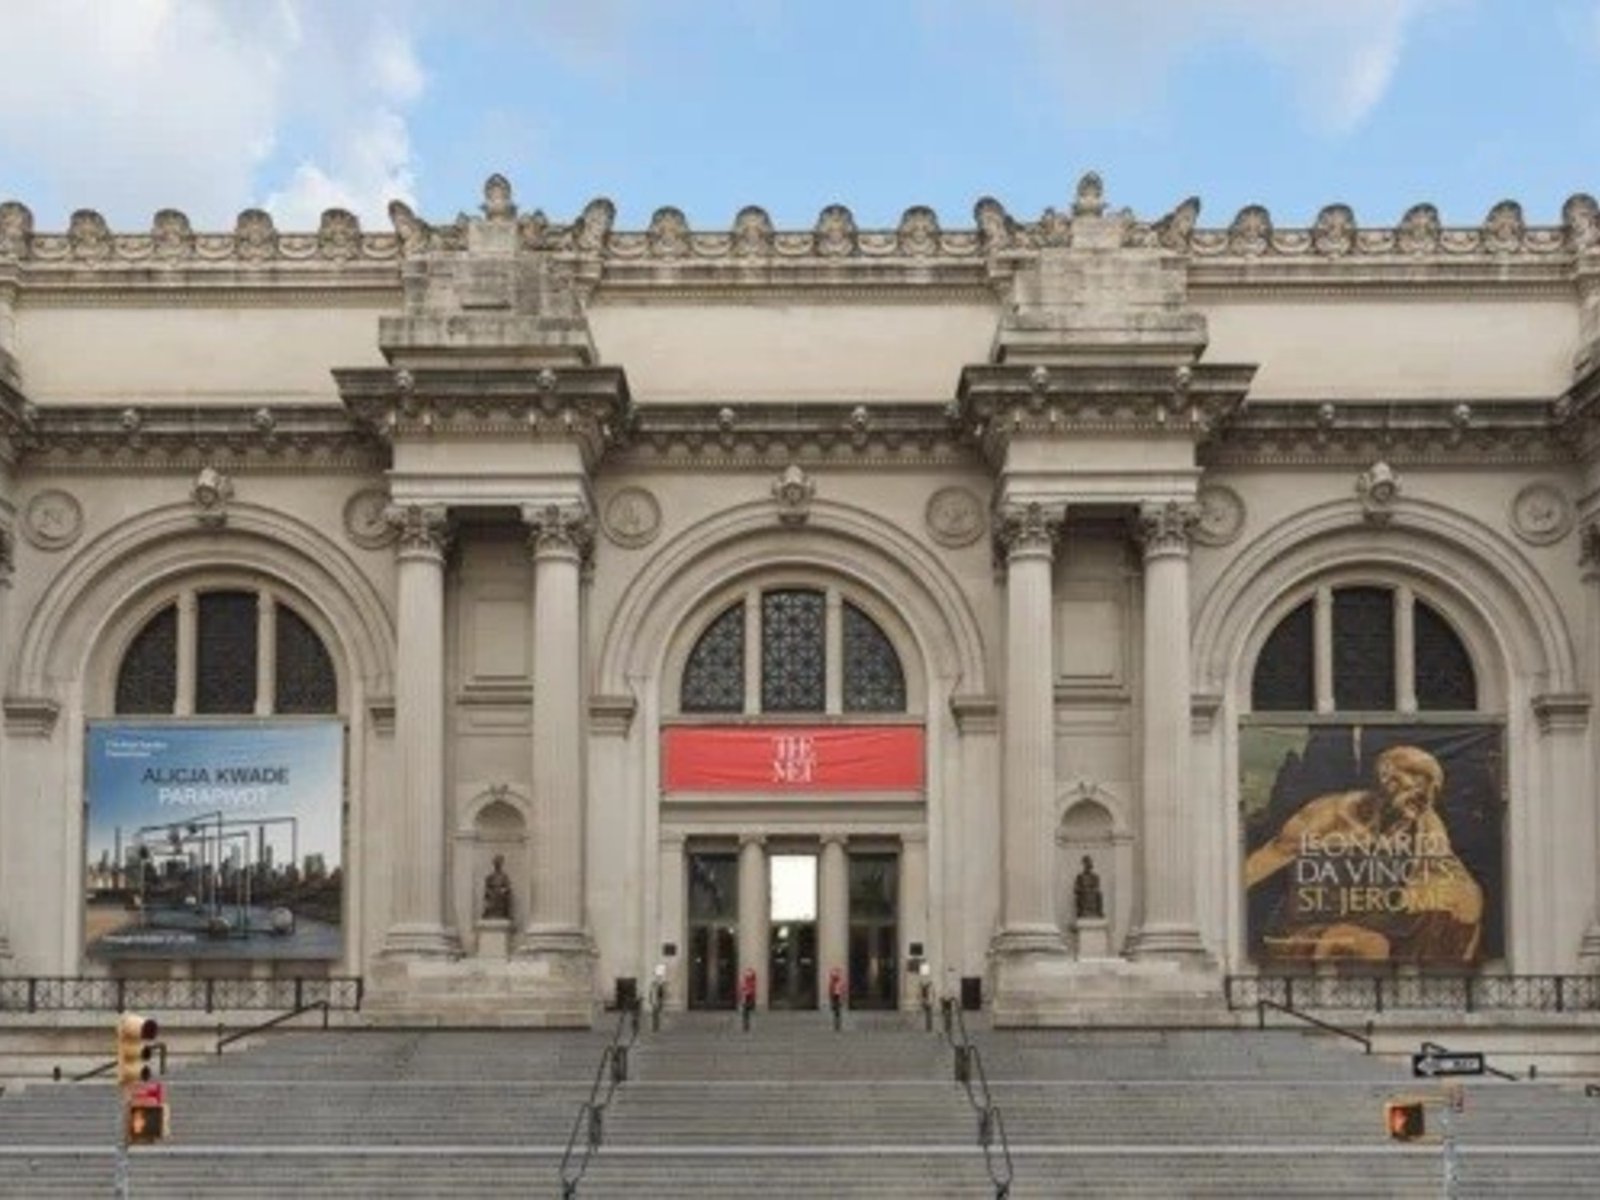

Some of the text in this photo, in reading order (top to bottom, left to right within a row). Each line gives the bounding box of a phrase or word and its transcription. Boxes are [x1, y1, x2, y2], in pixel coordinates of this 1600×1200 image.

[771, 735, 814, 760] THE
[141, 766, 290, 786] ALICJA KWADE
[158, 787, 269, 805] PARAPIVOT
[1297, 858, 1455, 886] DA VINCI'S
[1340, 887, 1454, 915] JEROME
